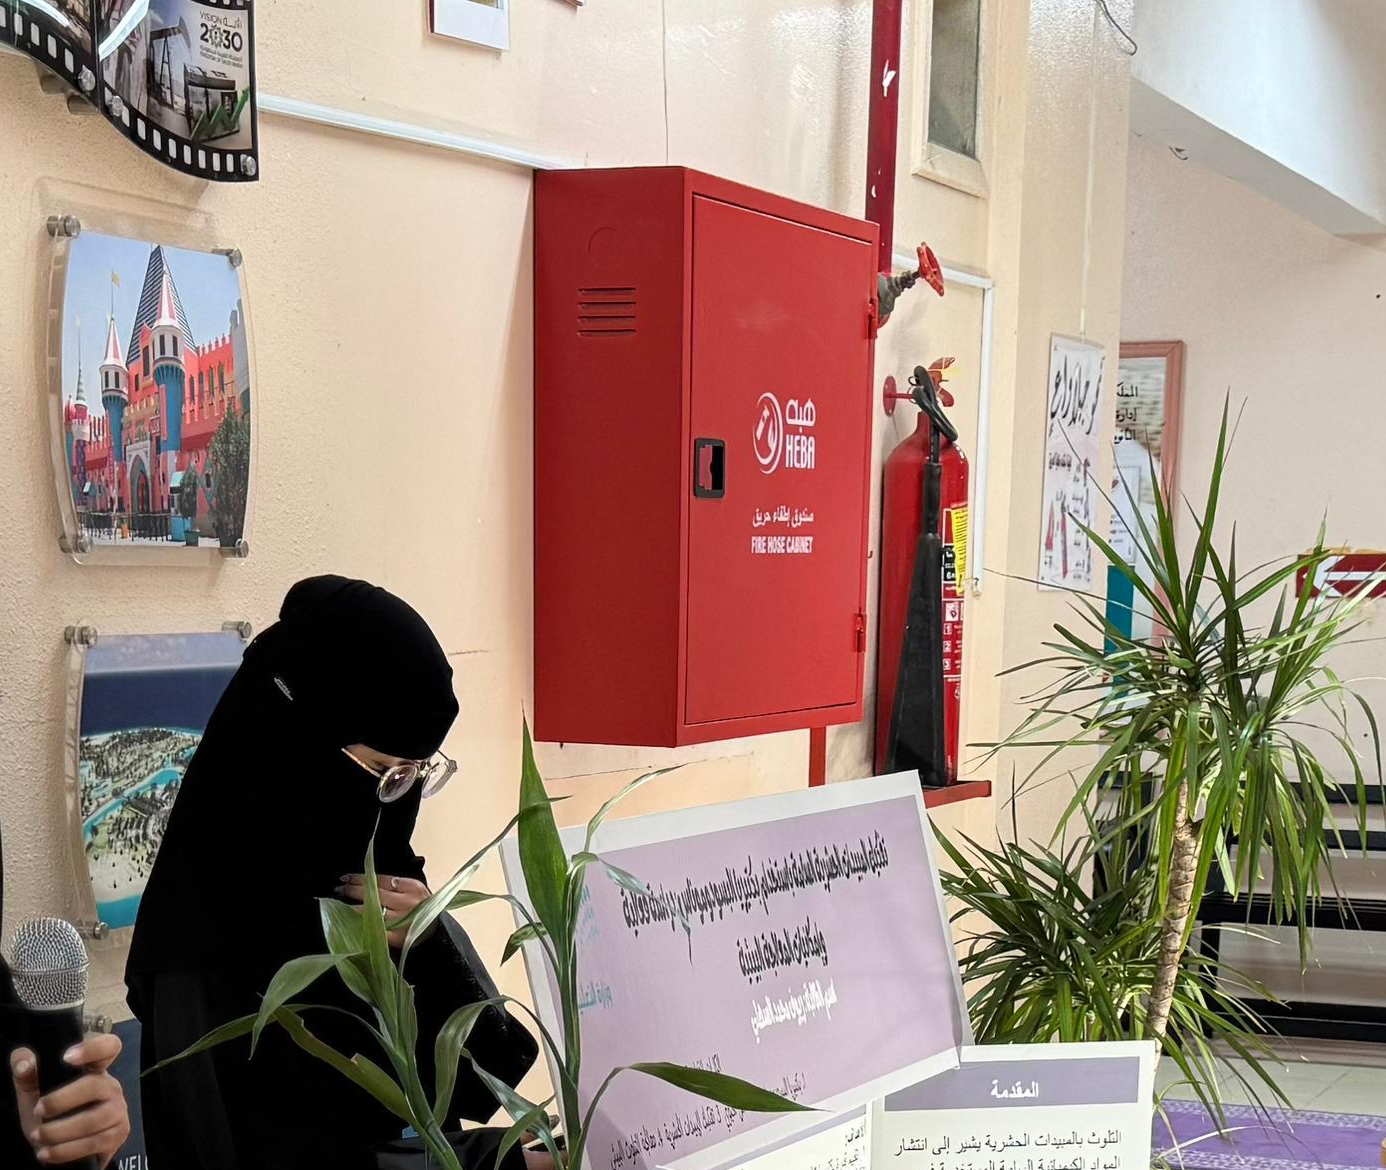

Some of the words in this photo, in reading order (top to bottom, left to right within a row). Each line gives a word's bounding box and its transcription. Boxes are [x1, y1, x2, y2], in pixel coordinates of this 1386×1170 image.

[785, 434, 816, 470] HEBA
[752, 507, 771, 528] حريق
[773, 505, 790, 527] إطفاء
[791, 507, 814, 528] صندوق
[751, 536, 767, 554] FIRE
[767, 536, 786, 554] HOSE
[786, 536, 813, 554] CABINET
[991, 1080, 1039, 1099] المقدمة
[894, 1137, 928, 1156] انتشار
[932, 1136, 950, 1155] إلى
[955, 1135, 982, 1155] يشير
[985, 1133, 1030, 1152] الحشرية
[1035, 1131, 1083, 1147] بالمبيدات
[1087, 1129, 1122, 1149] التلوث
